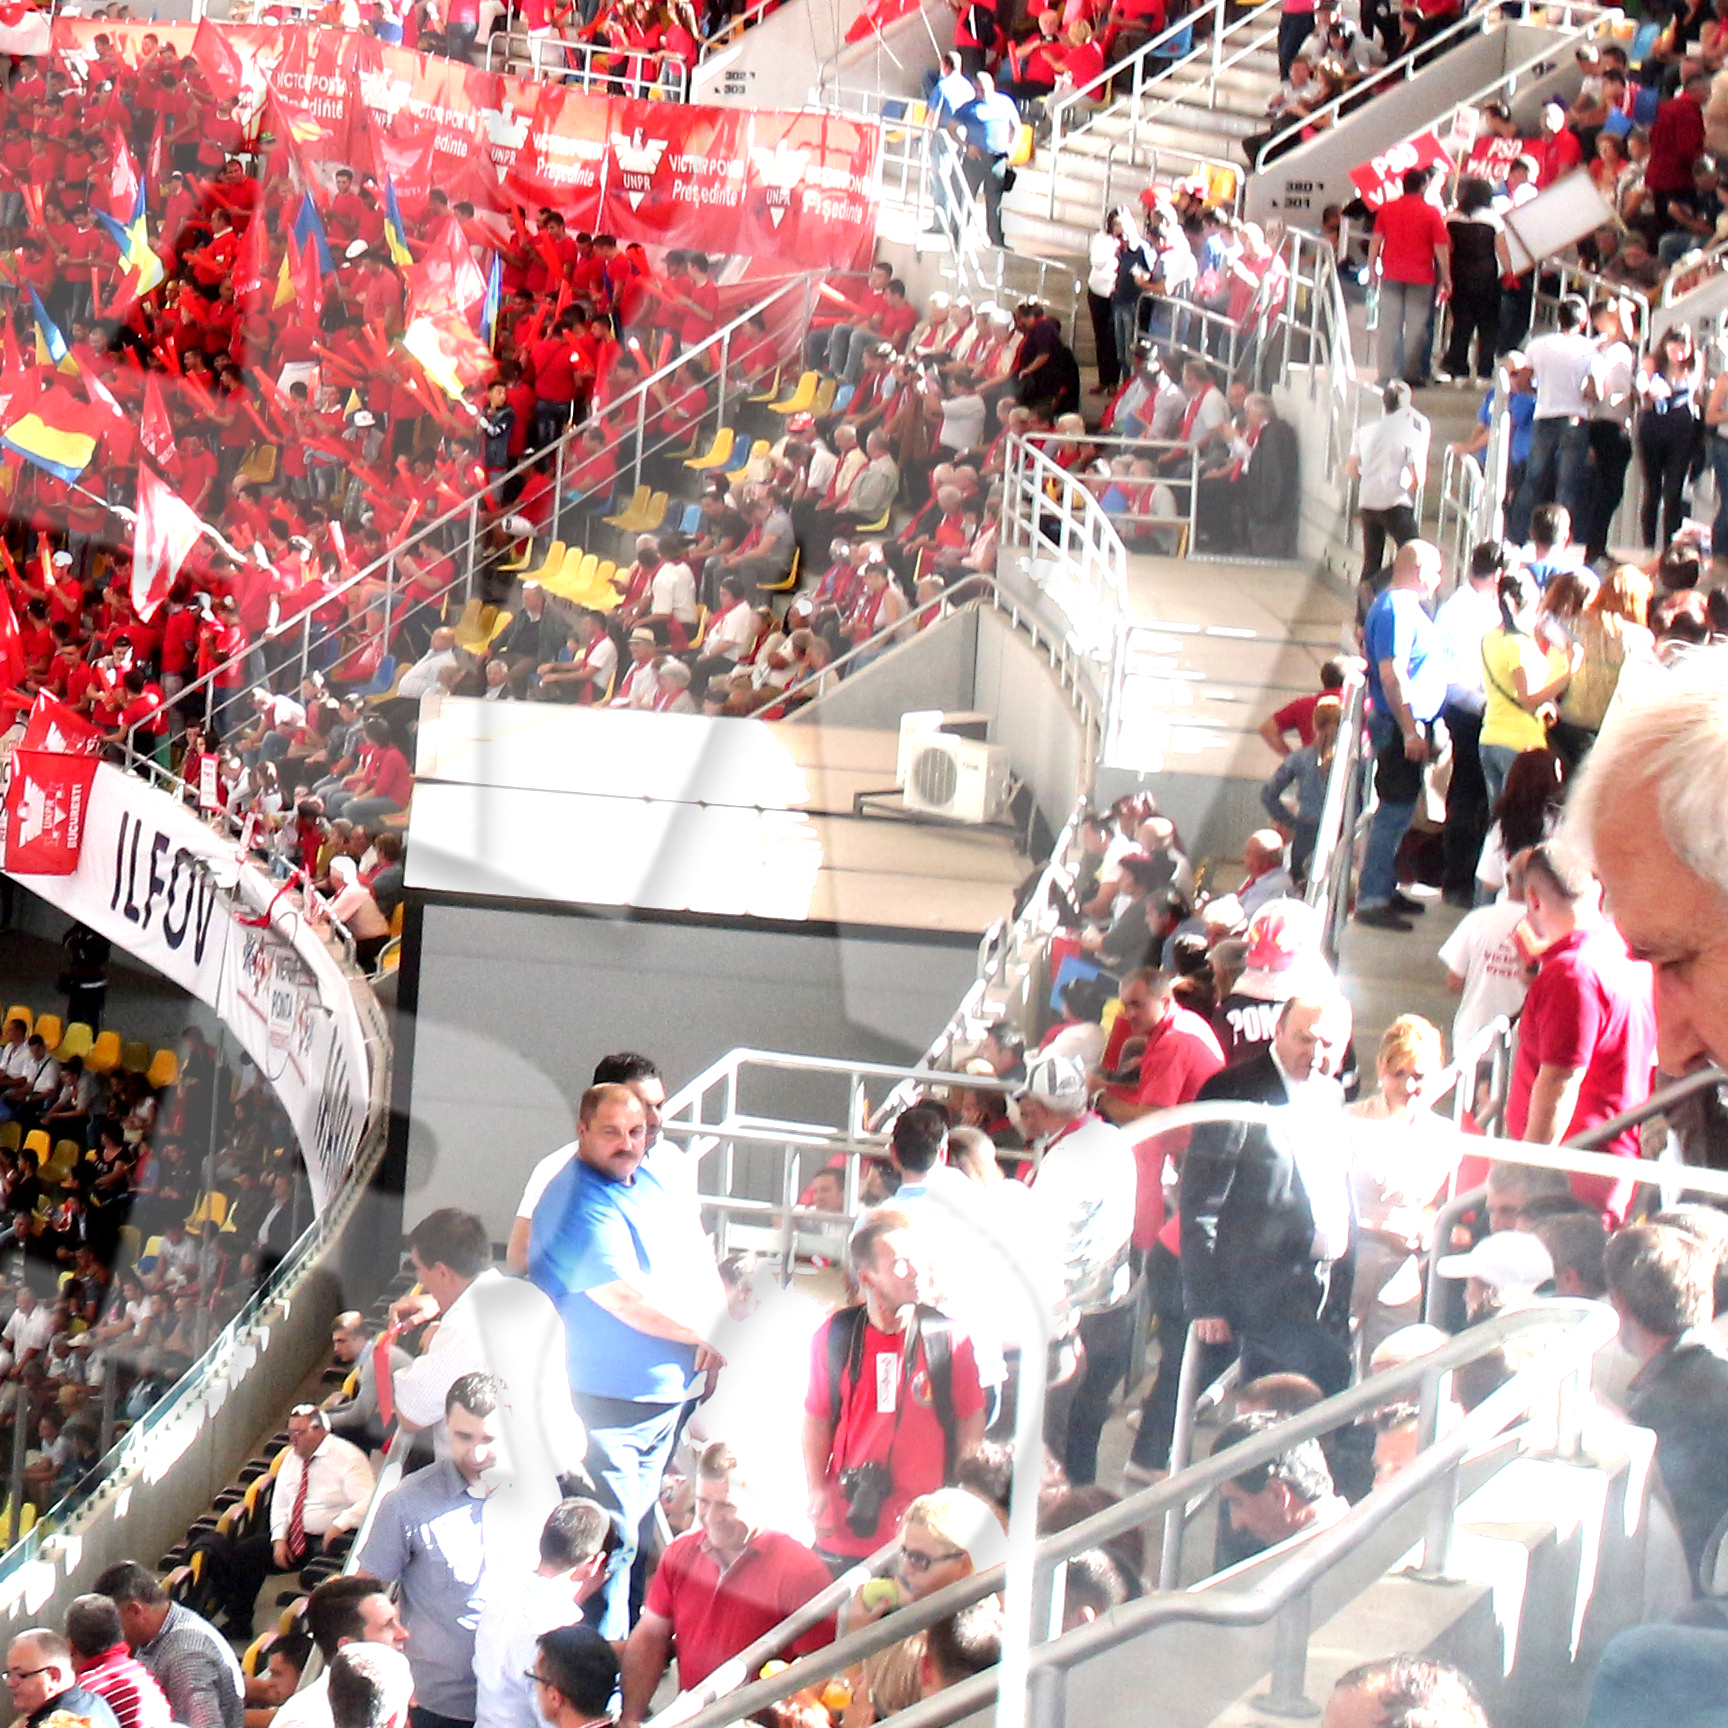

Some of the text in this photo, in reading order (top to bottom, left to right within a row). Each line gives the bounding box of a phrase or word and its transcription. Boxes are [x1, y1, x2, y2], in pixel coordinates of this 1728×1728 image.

[491, 148, 516, 166] UNPR
[623, 174, 651, 192] UNPR
[110, 811, 219, 965] ILFOV
